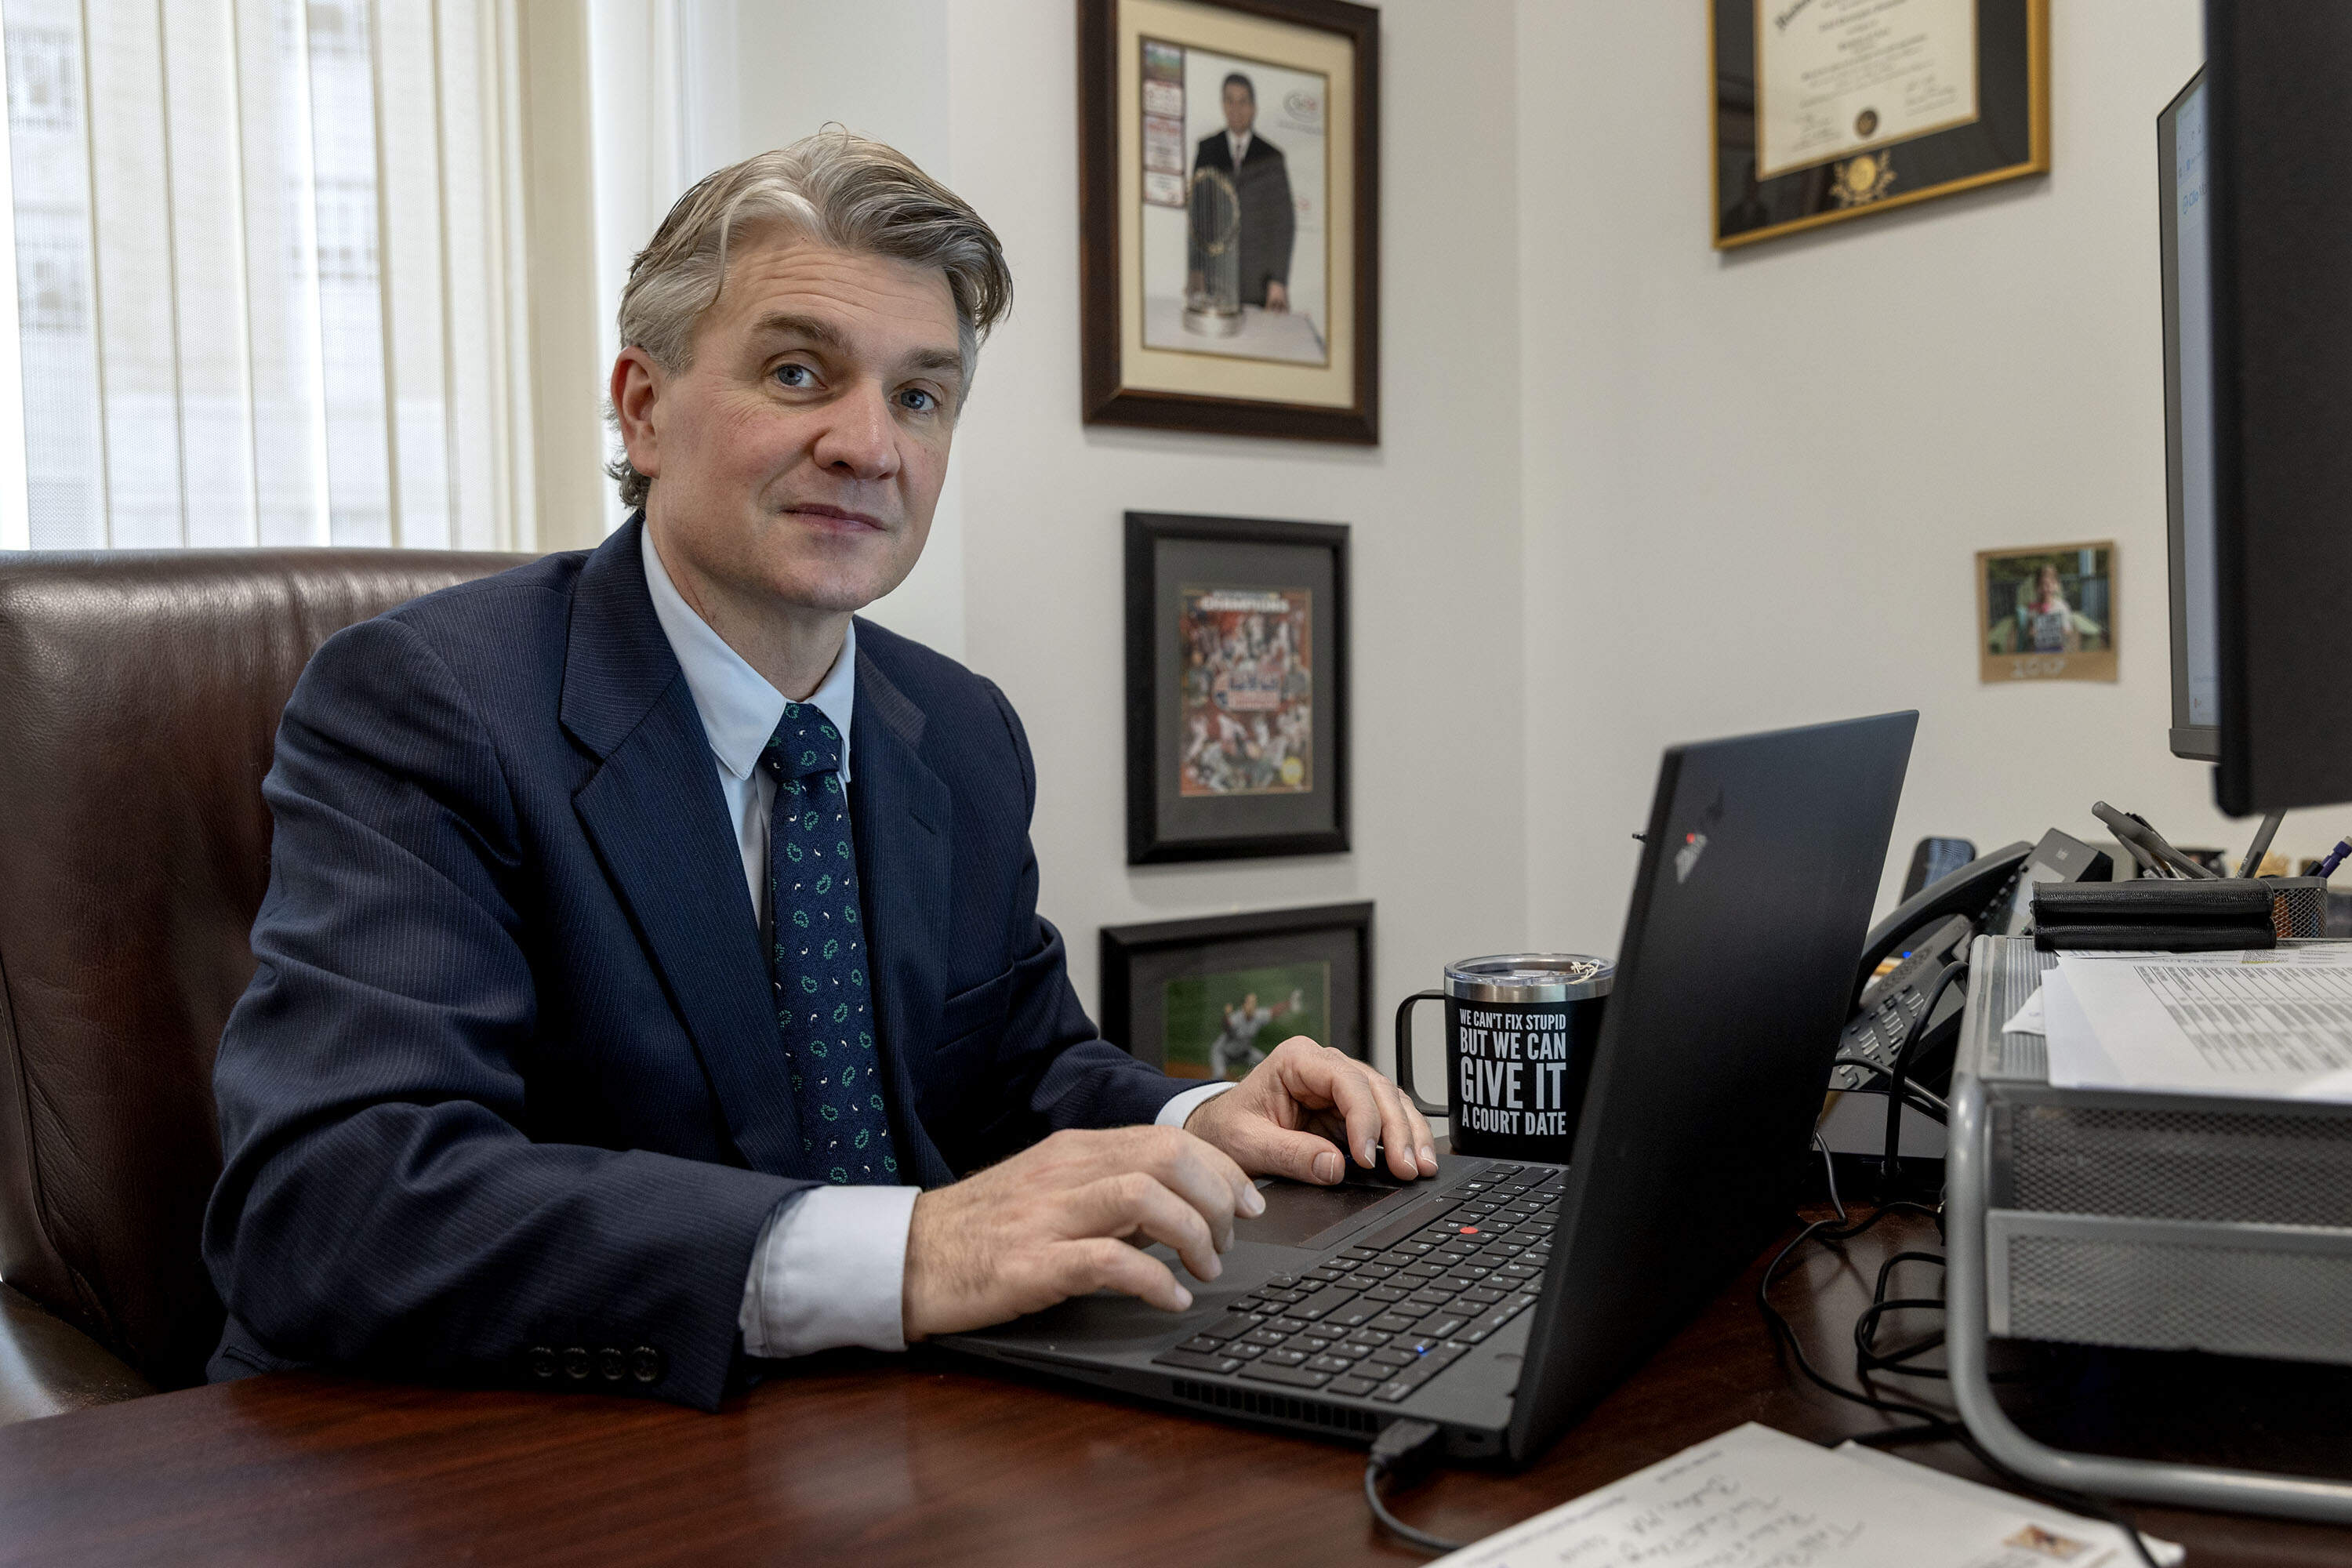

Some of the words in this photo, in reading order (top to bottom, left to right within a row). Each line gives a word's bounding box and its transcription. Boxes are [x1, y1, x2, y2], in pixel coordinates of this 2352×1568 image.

[1460, 1008, 1472, 1025] WE
[1473, 1011, 1501, 1028] CAN'T
[1505, 1014, 1523, 1029] FIX
[1526, 1014, 1566, 1030] STUPID
[1460, 1026, 1488, 1057] BUT
[1492, 1031, 1521, 1059] WE
[1526, 1033, 1566, 1060] CAN
[1460, 1056, 1523, 1109] GIVE
[1536, 1062, 1567, 1109] IT
[1461, 1104, 1470, 1128] A
[1472, 1106, 1520, 1134] COURT
[1525, 1111, 1567, 1135] DATE
